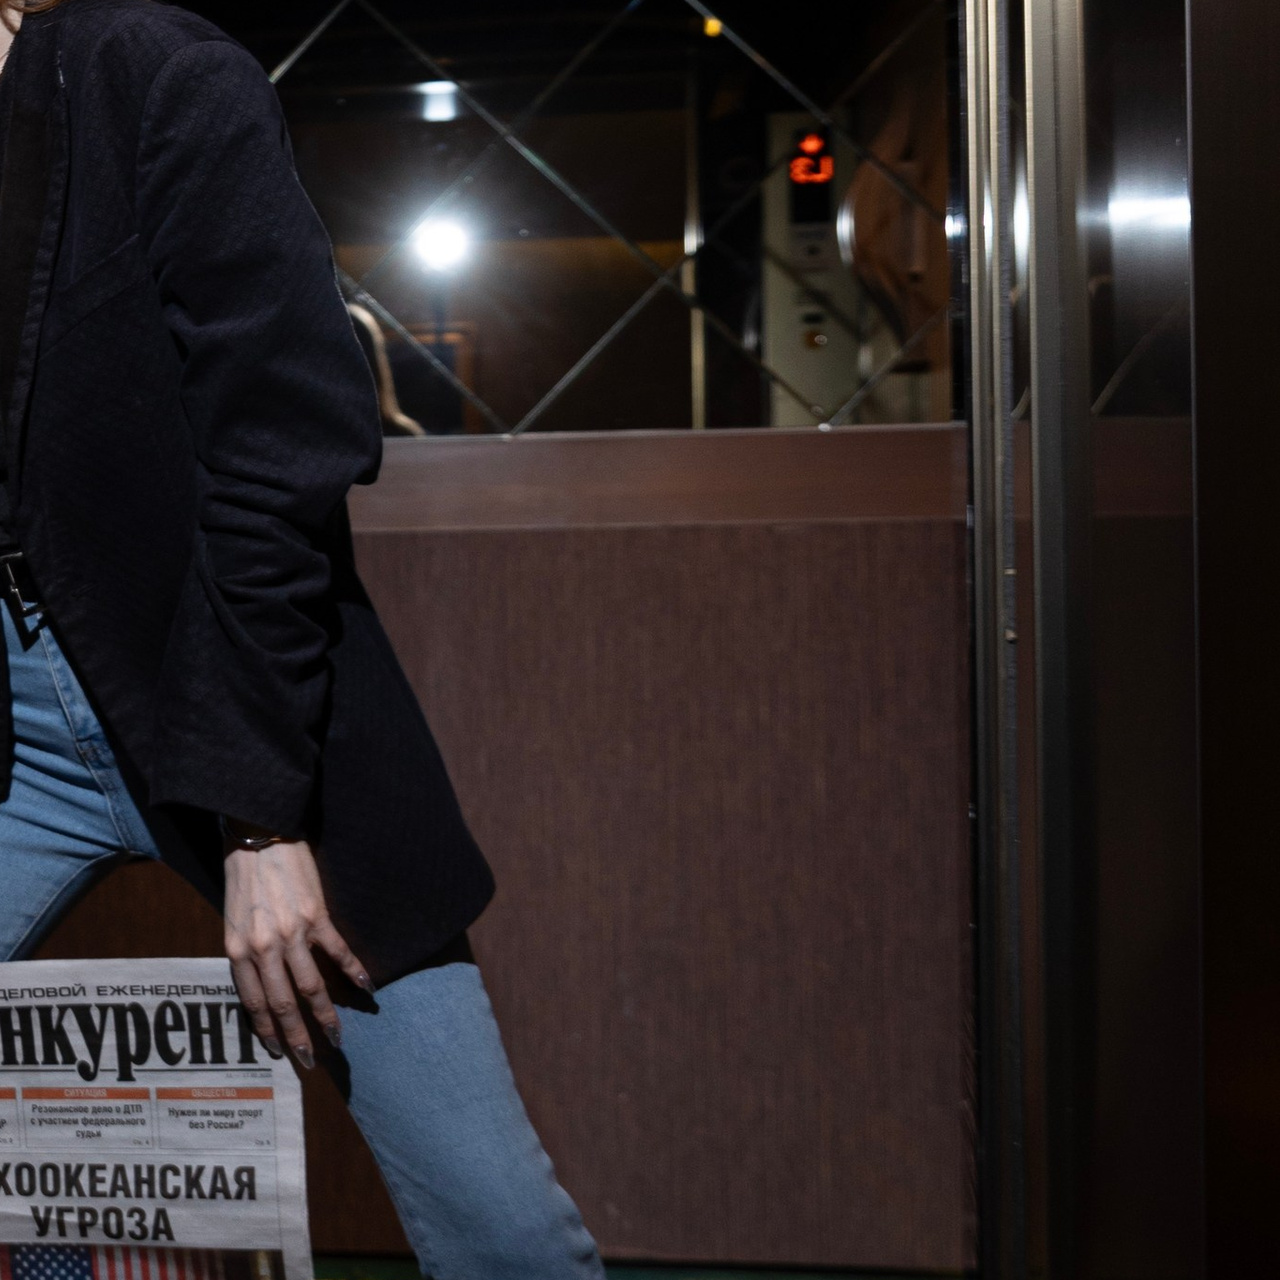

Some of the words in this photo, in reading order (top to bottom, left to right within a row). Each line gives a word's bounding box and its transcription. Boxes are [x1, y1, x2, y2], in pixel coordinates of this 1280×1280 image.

[97, 983, 239, 999] ЕЖЕНЕДЕЛЬНИ
[63, 1088, 107, 1098] СИТУАЦИЯ
[191, 1088, 237, 1098] ОБЩЕСТВО
[31, 1104, 89, 1113] Резонансное
[91, 1106, 113, 1114] дело
[123, 1104, 143, 1114] ДТП
[168, 1107, 197, 1118] Нужен
[237, 1109, 263, 1118] спорт
[37, 1117, 79, 1126] участием
[81, 1116, 146, 1127] федерального
[188, 1120, 205, 1129] без
[207, 1120, 245, 1129] России?
[75, 1129, 102, 1139] судьи
[30, 1205, 176, 1241] УГРОЗА
